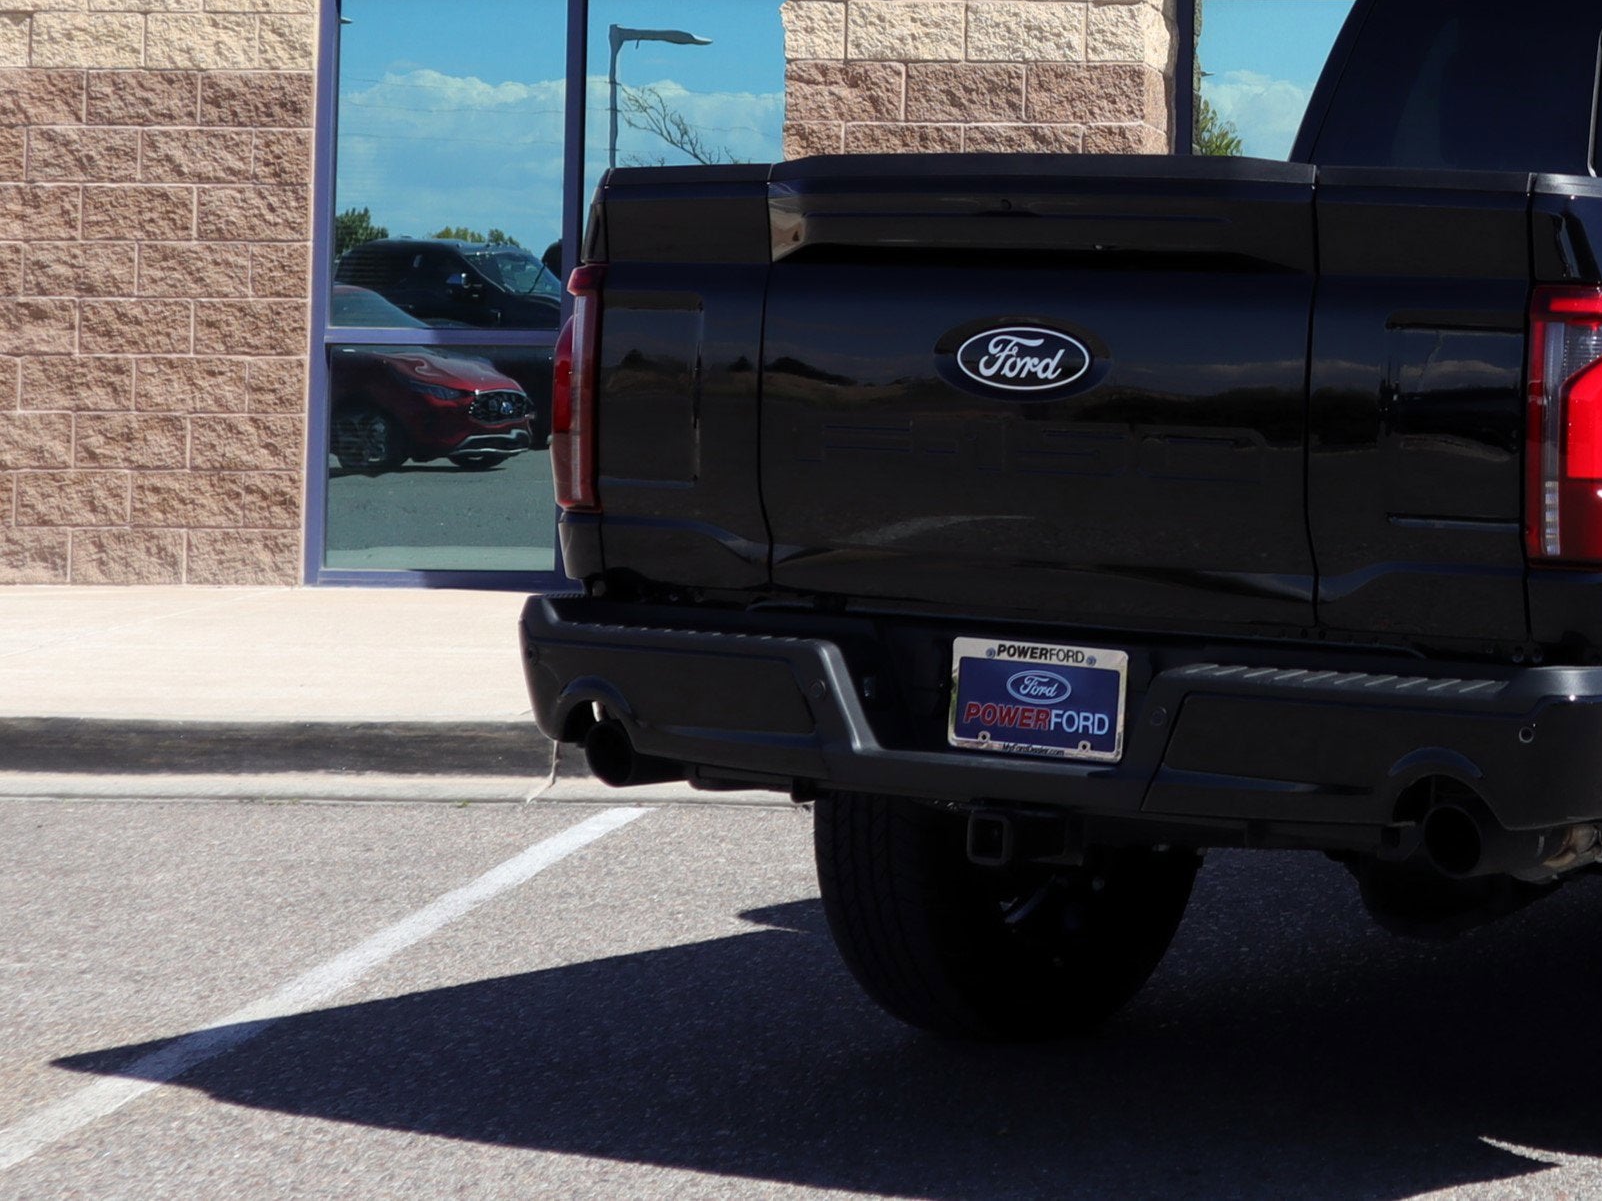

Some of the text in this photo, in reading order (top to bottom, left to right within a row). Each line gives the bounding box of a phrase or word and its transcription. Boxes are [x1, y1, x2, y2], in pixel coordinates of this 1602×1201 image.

[979, 335, 1065, 380] Ford
[996, 643, 1085, 664] POWERFORD
[1019, 674, 1058, 698] Ford
[963, 701, 1110, 736] POWERFORD
